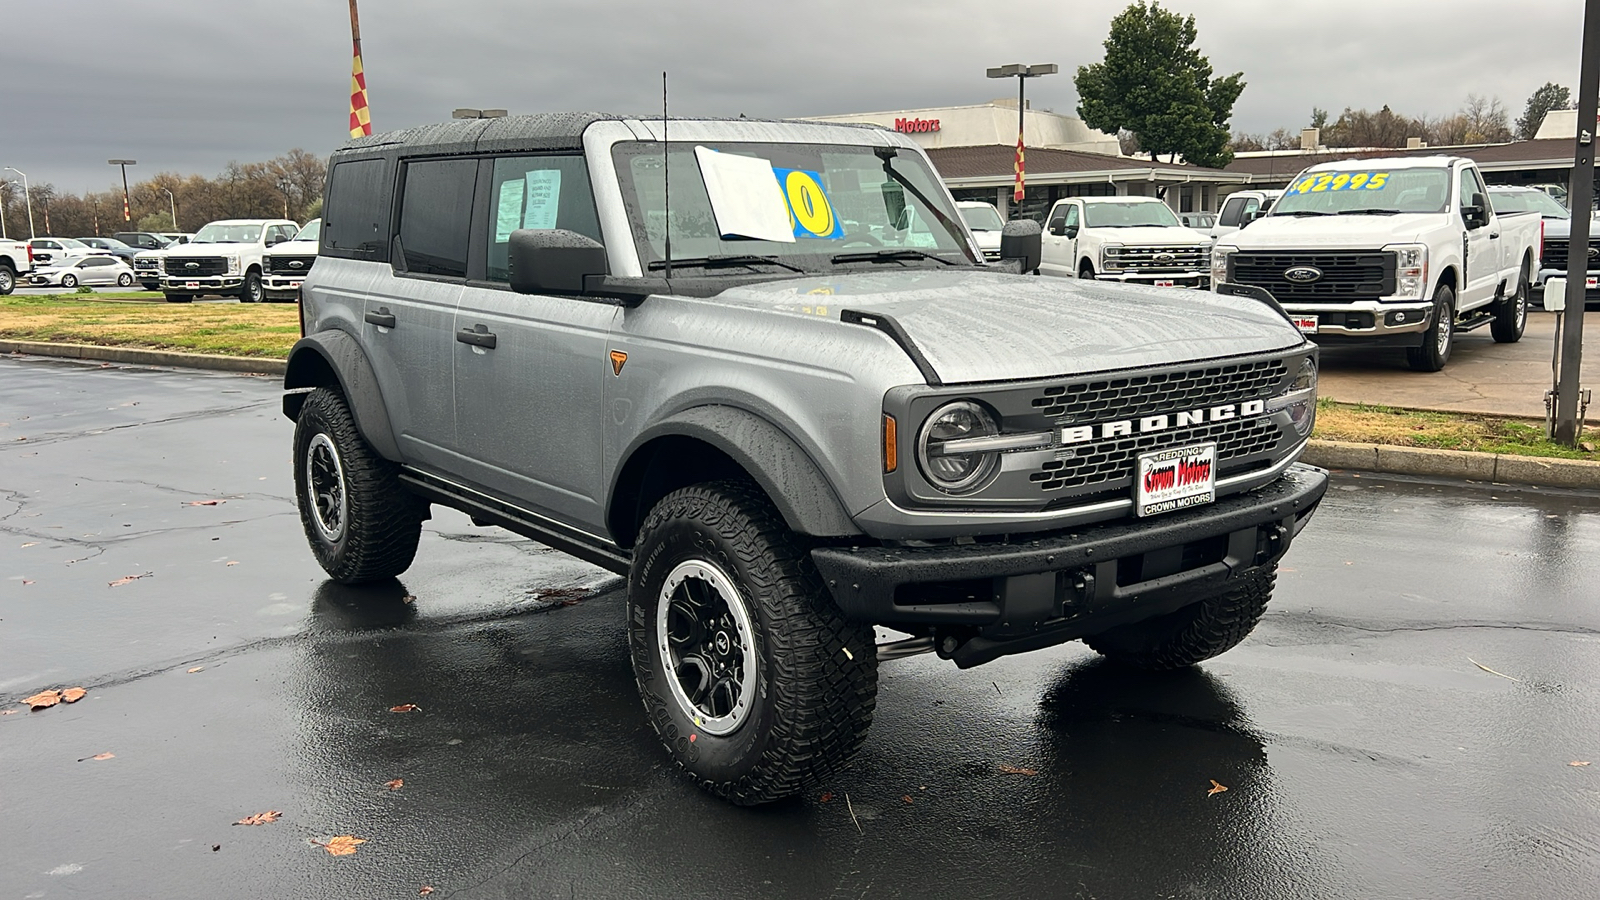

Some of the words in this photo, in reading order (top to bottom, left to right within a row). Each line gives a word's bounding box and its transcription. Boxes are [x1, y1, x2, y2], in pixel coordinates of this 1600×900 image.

[895, 117, 941, 133] Motors
[1289, 172, 1390, 194] $42995
[1291, 269, 1313, 280] Ford
[1060, 399, 1265, 445] BRONCO
[1159, 447, 1199, 461] REDDING
[1144, 463, 1175, 493] Crown
[1177, 457, 1211, 487] Motors
[1145, 500, 1176, 514] CROWN
[1177, 493, 1211, 507] MOTORS
